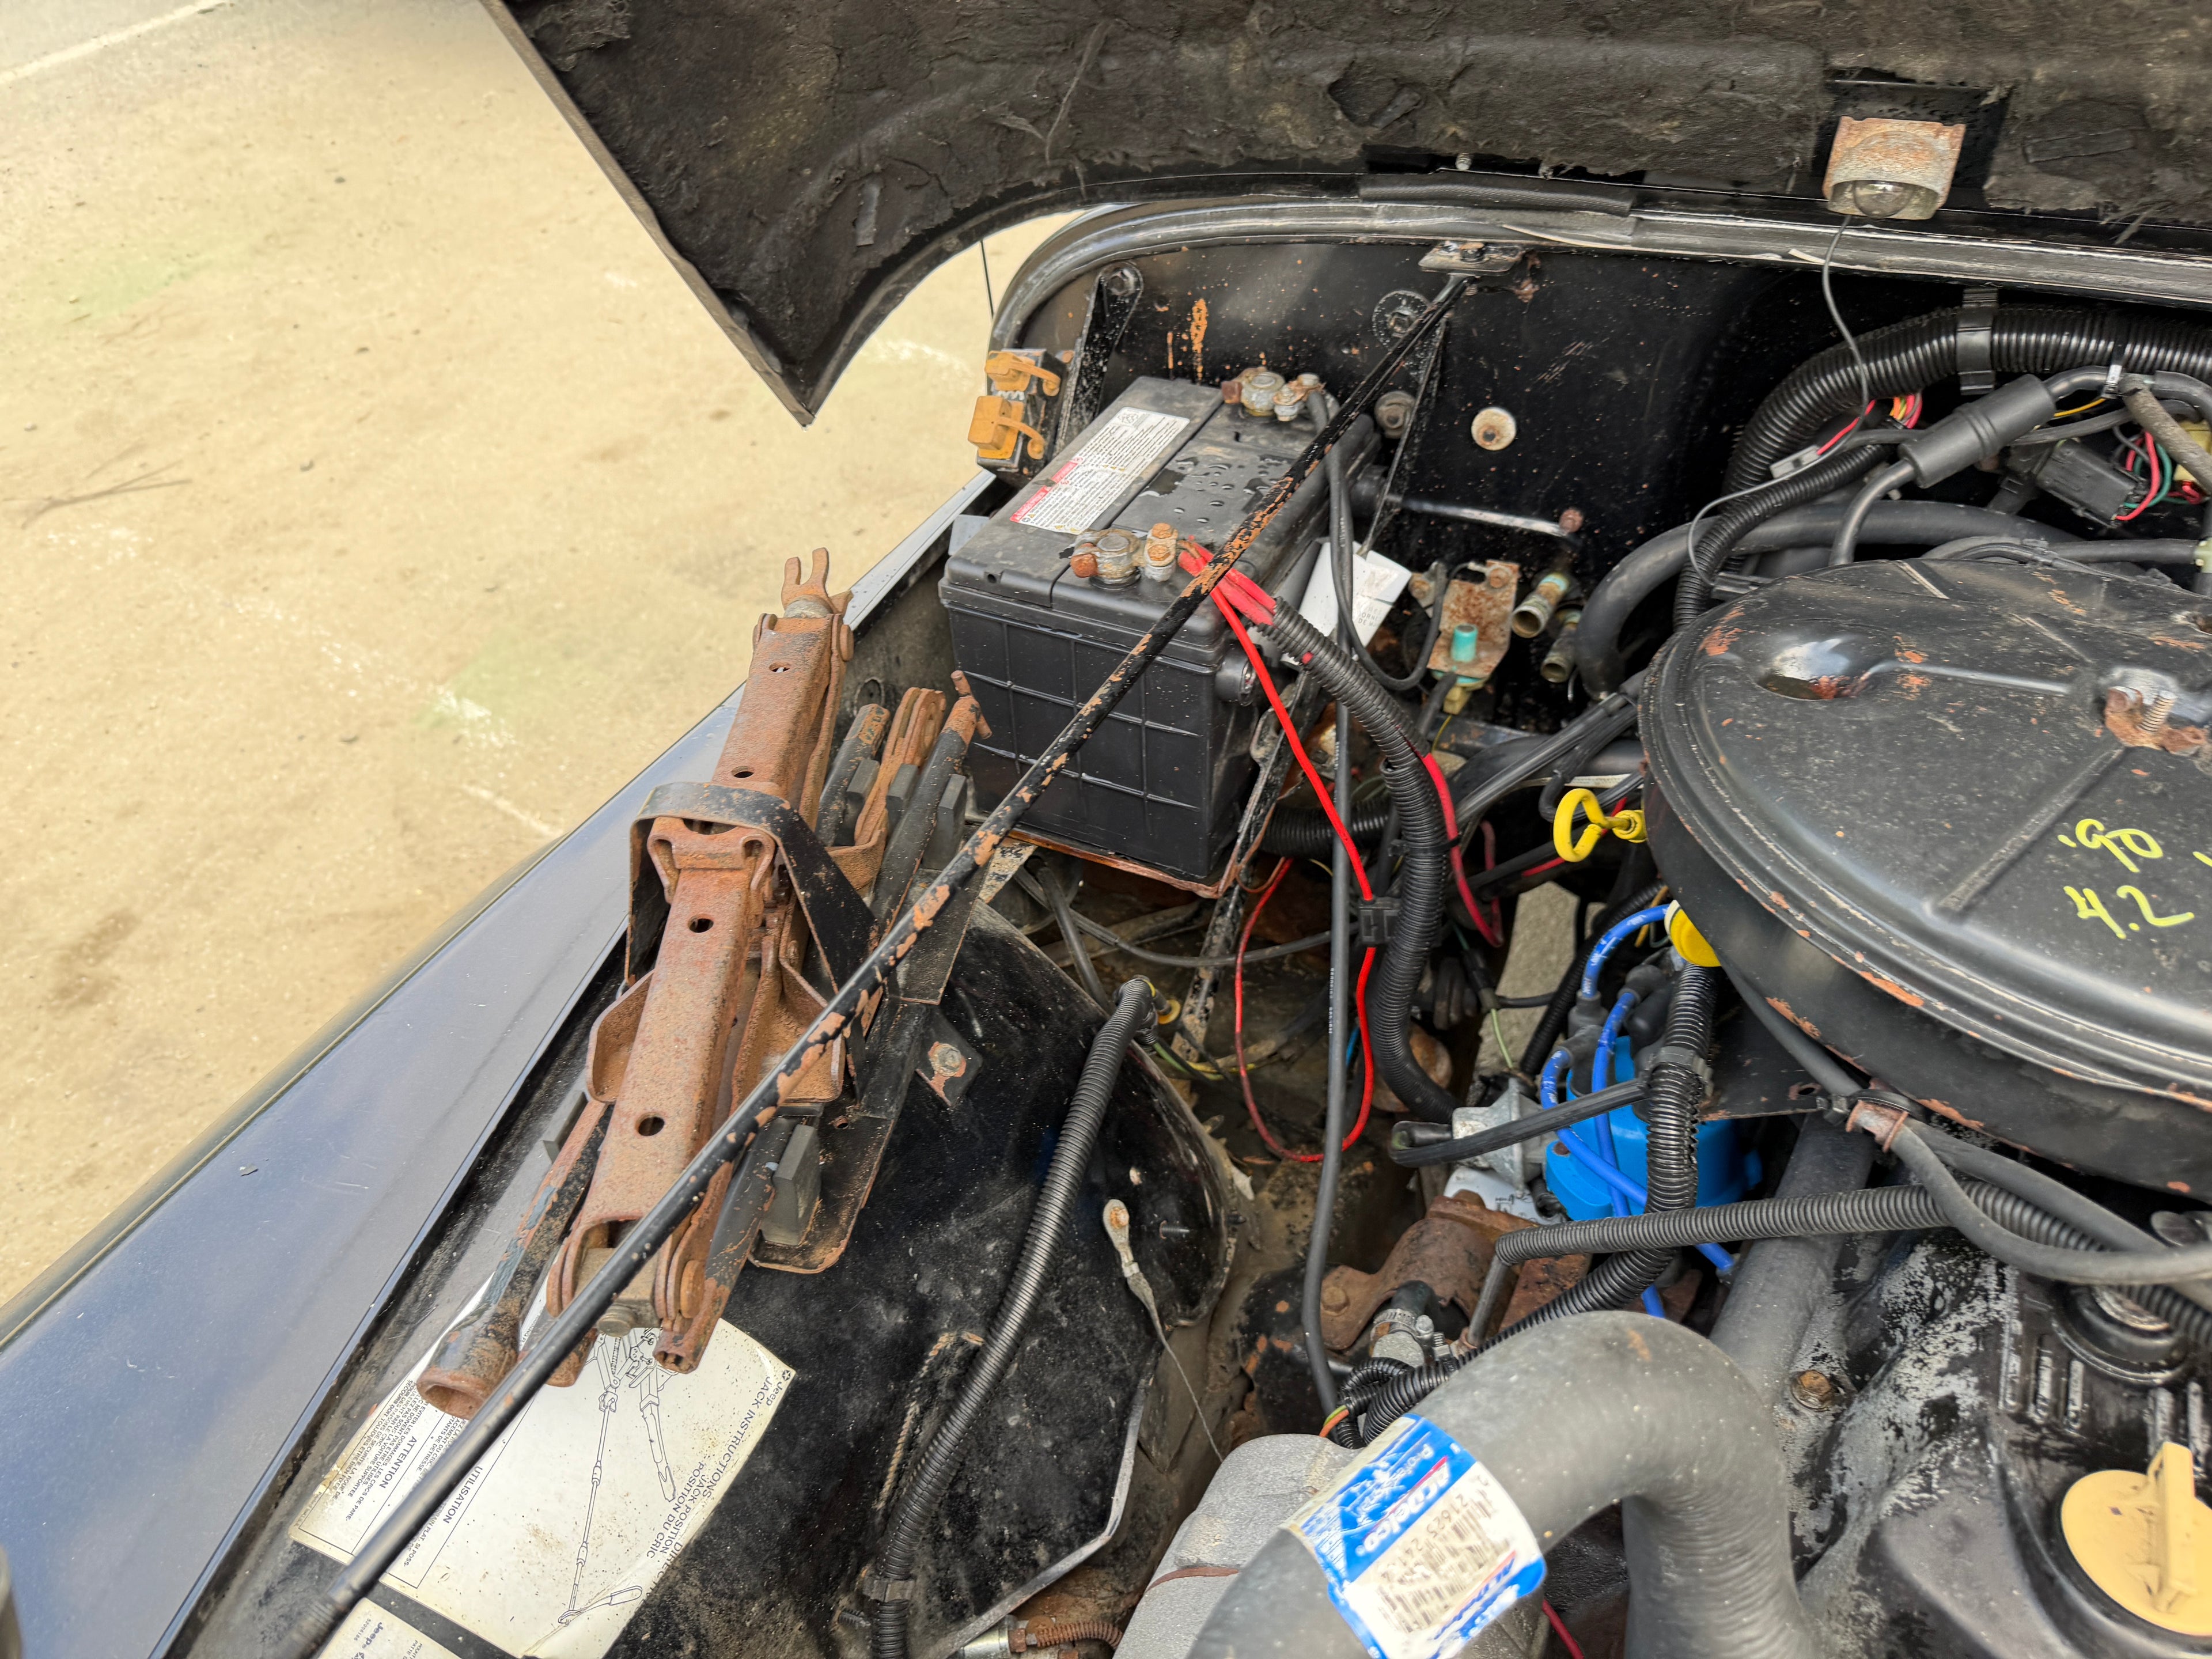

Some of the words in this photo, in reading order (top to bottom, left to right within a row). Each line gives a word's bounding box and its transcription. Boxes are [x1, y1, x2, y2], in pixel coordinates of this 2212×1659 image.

[2063, 885, 2195, 940] 4.2
[393, 1379, 412, 1404] SECOURS
[404, 1382, 416, 1396] POUR
[751, 1376, 771, 1410] JACK
[765, 1381, 783, 1407] Jeep
[384, 1404, 394, 1417] DOIT
[396, 1397, 405, 1407] DES
[412, 1404, 419, 1412] NE
[380, 1408, 397, 1431] RAISONS
[391, 1414, 399, 1425] PAR
[402, 1407, 411, 1418] PAS
[411, 1406, 425, 1424] EVITER
[363, 1418, 384, 1446] TOUJOURS
[391, 1418, 403, 1433] SOUS
[397, 1412, 414, 1434] DOIVENT
[403, 1425, 412, 1435] LES
[374, 1431, 381, 1439] DE
[389, 1435, 398, 1446] PAS
[435, 1435, 442, 1443] DE
[353, 1446, 365, 1461] ETRE
[370, 1441, 387, 1465] VOITURE
[379, 1446, 391, 1461] ETRE
[435, 1444, 442, 1452] DU
[702, 1408, 756, 1500] INSTRUCTIONS
[344, 1461, 354, 1474] BIEN
[349, 1467, 357, 1475] LA
[379, 1435, 418, 1490] ATTENTION
[348, 1465, 371, 1497] SUPPORTEE
[374, 1468, 382, 1478] LES
[339, 1475, 351, 1491] ROUE
[362, 1479, 375, 1495] CRICS
[672, 1461, 705, 1513] POSITION
[688, 1474, 708, 1505] JACK
[332, 1491, 340, 1499] DE
[356, 1496, 363, 1505] DE
[443, 1465, 483, 1524] UTILISATION
[1361, 1462, 1450, 1552] ACDelco
[1424, 1493, 1469, 1538] 21625
[659, 1504, 692, 1554] POSITION
[662, 1513, 676, 1531] DU
[646, 1532, 666, 1559] CRIC
[1379, 1540, 1425, 1580] 2414
[366, 1622, 384, 1646] Jeep
